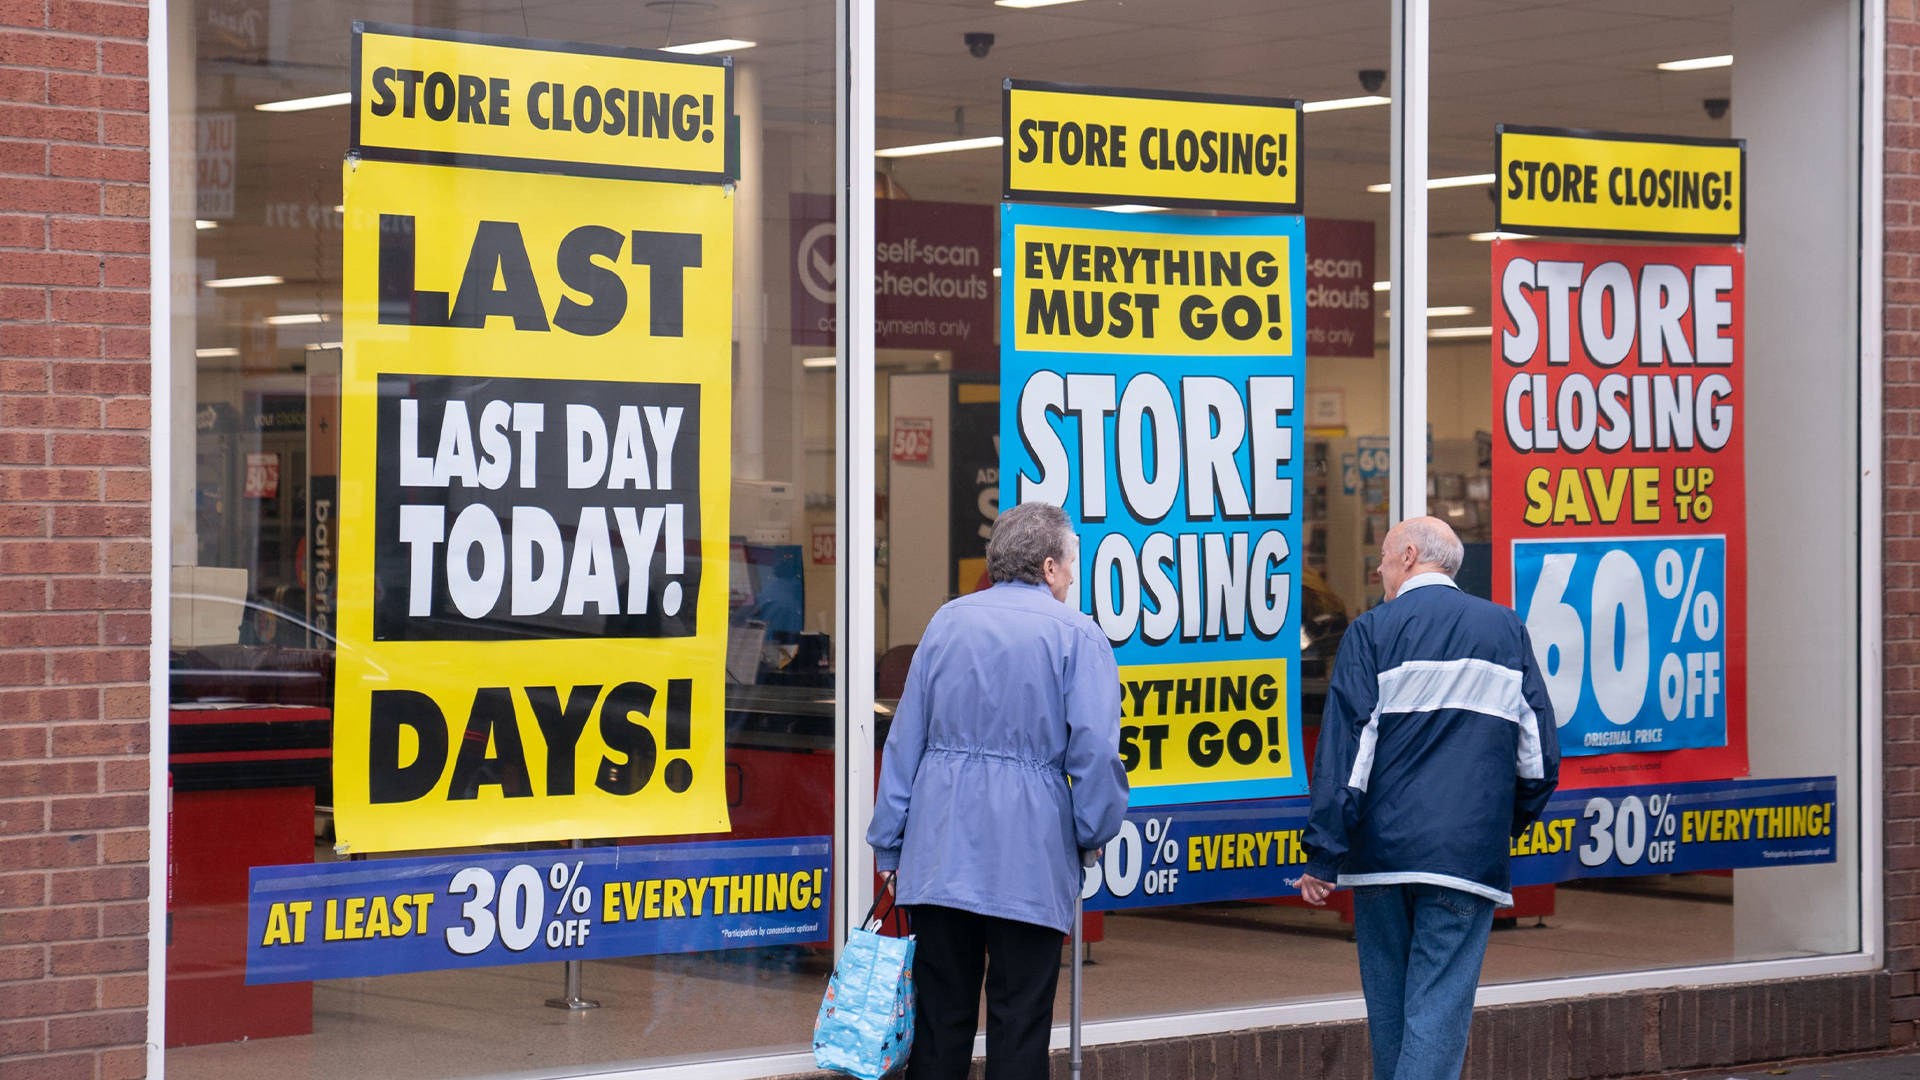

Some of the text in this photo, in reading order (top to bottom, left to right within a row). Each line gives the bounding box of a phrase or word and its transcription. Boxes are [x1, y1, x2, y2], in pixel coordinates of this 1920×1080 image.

[371, 66, 715, 144] STORE CLOSING!
[1018, 118, 1288, 177] STORE CLOSING!
[1507, 159, 1733, 211] STORE CLOSING!
[378, 213, 703, 338] LAST
[876, 238, 980, 267] self-scan
[1025, 241, 1279, 288] EVERYTHING
[1305, 253, 1363, 279] -scan
[875, 317, 971, 340] ayments only
[1025, 288, 1283, 341] MUST GO!
[1306, 283, 1370, 310] ckouts
[1501, 257, 1734, 368] STORE
[1327, 326, 1355, 347] only
[400, 398, 684, 491] LAST DAY
[1503, 372, 1734, 453] CLOSING
[1017, 369, 1295, 524] STORE
[1522, 467, 1715, 528] SAVE UP TO
[315, 499, 331, 650] batteries
[400, 503, 686, 620] TODAY!
[1064, 529, 1291, 648] OSING
[1525, 547, 1721, 728] 60% OFF
[1120, 673, 1280, 717] YTHING
[369, 678, 694, 805] DAYS!
[1118, 716, 1282, 773] ST GO!
[1584, 728, 1663, 747] ORIGINAL PRICE
[1579, 793, 1676, 867] 30%
[1648, 840, 1675, 865] OFF
[1143, 868, 1179, 896] OFF
[1187, 829, 1308, 873] EVERYTH
[261, 901, 313, 947] AT
[323, 892, 435, 942] LEAST
[445, 860, 592, 956] 30%
[546, 917, 591, 950] OFF
[759, 926, 766, 937] by
[766, 924, 796, 936] concessions
[796, 921, 819, 934] optional
